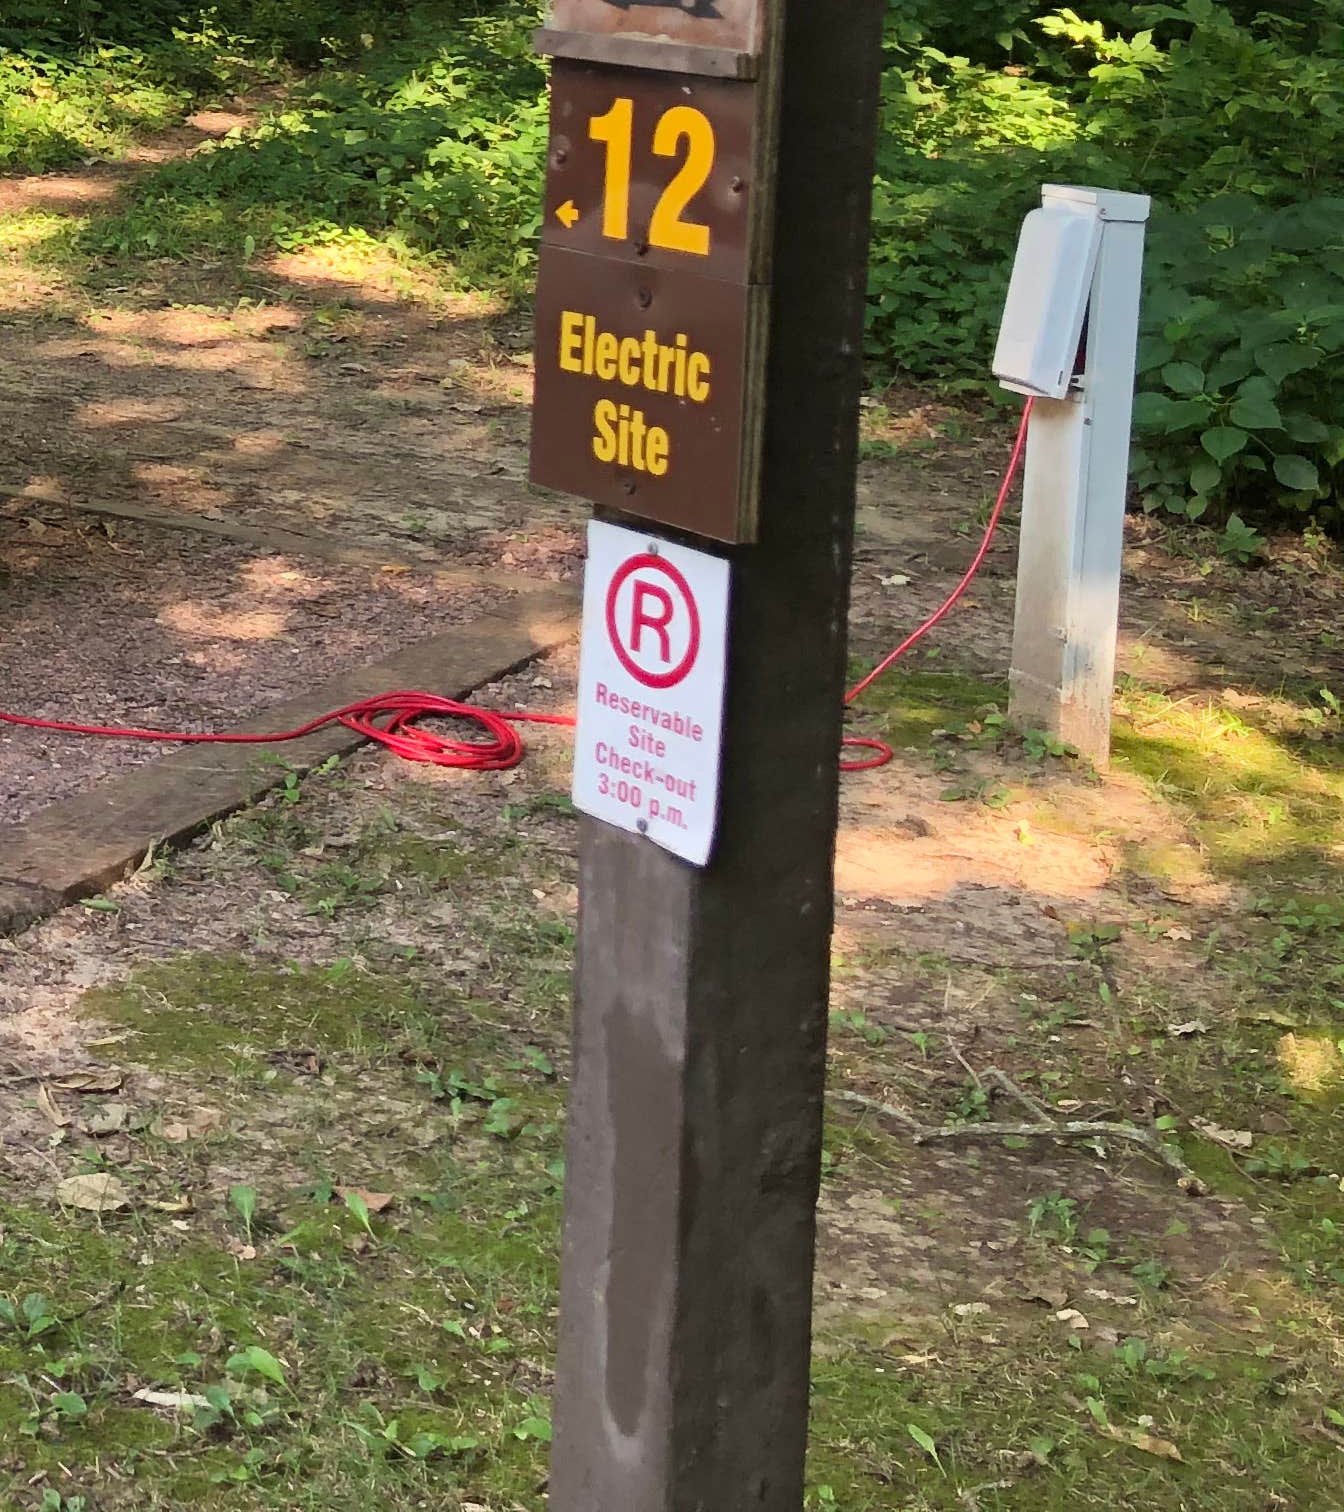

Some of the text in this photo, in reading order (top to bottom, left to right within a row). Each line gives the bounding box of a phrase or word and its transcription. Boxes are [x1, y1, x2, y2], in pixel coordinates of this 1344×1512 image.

[588, 98, 715, 256] 12
[560, 310, 711, 404] Electric
[593, 398, 670, 476] Site
[629, 579, 674, 663] R
[596, 681, 704, 742] Reservable
[628, 724, 666, 758] Site
[595, 742, 697, 802] Check-out
[598, 773, 688, 829] 3:00 p.m.
